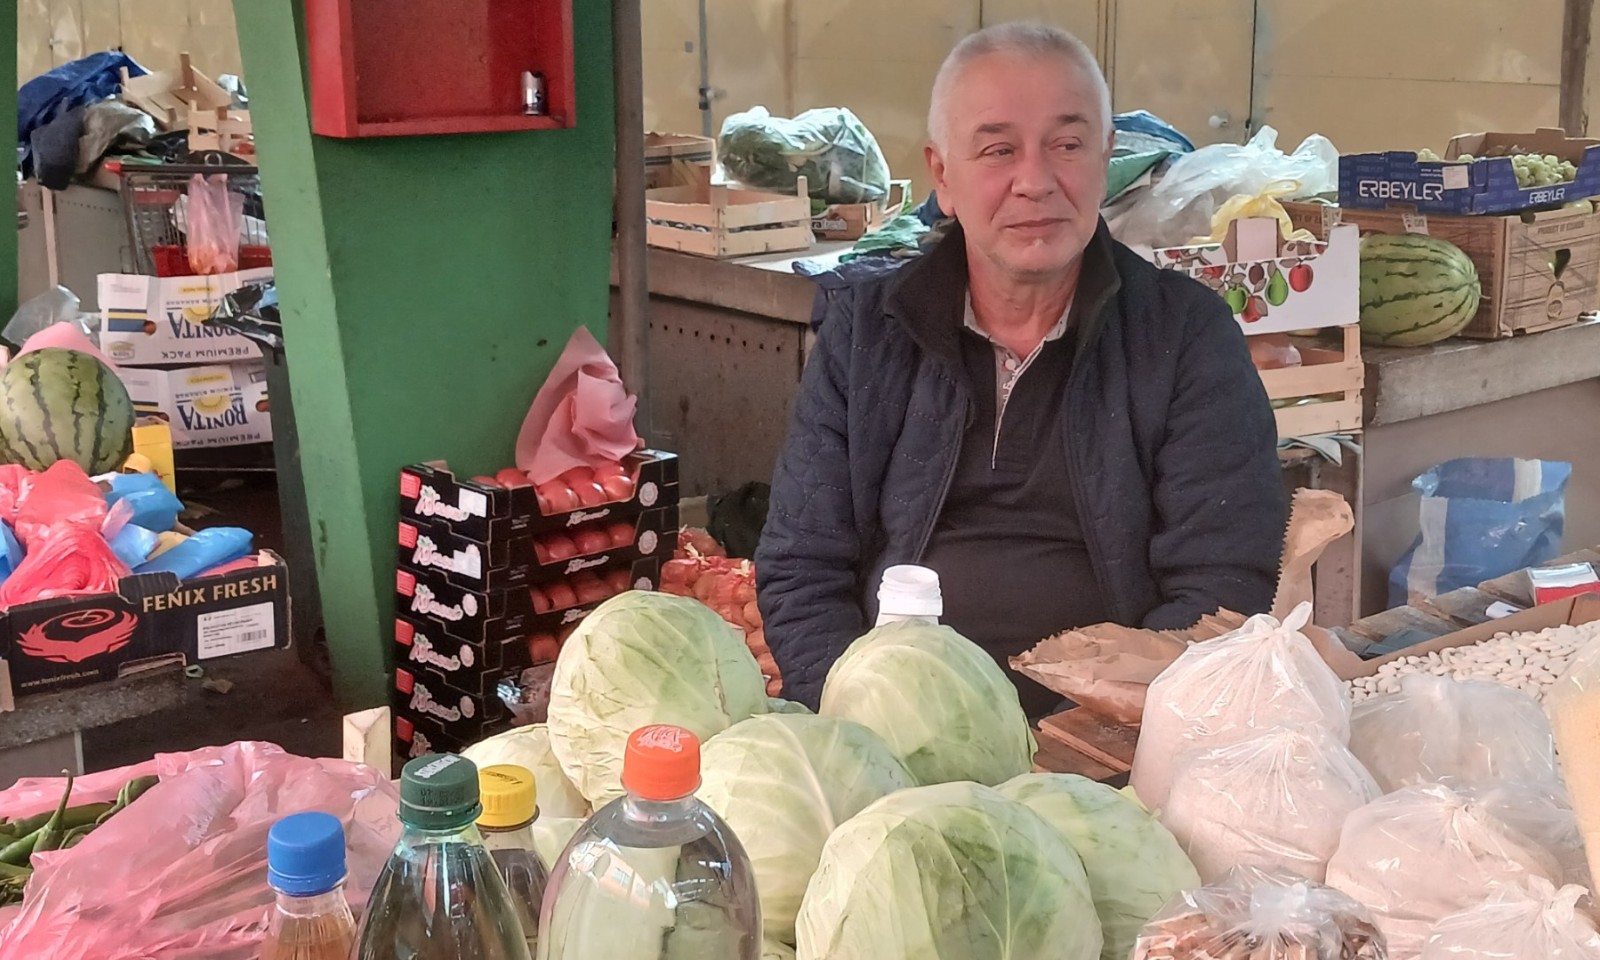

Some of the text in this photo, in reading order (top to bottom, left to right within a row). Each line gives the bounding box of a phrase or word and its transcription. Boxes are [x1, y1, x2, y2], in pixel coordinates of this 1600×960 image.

[1360, 180, 1443, 200] ERBEYLER
[1529, 188, 1565, 204] ERBEYLER
[161, 346, 249, 359] PREMIUM PACK
[177, 397, 249, 431] BONITA
[207, 432, 261, 444] PREMIUM
[143, 574, 277, 613] FENIX FRESH
